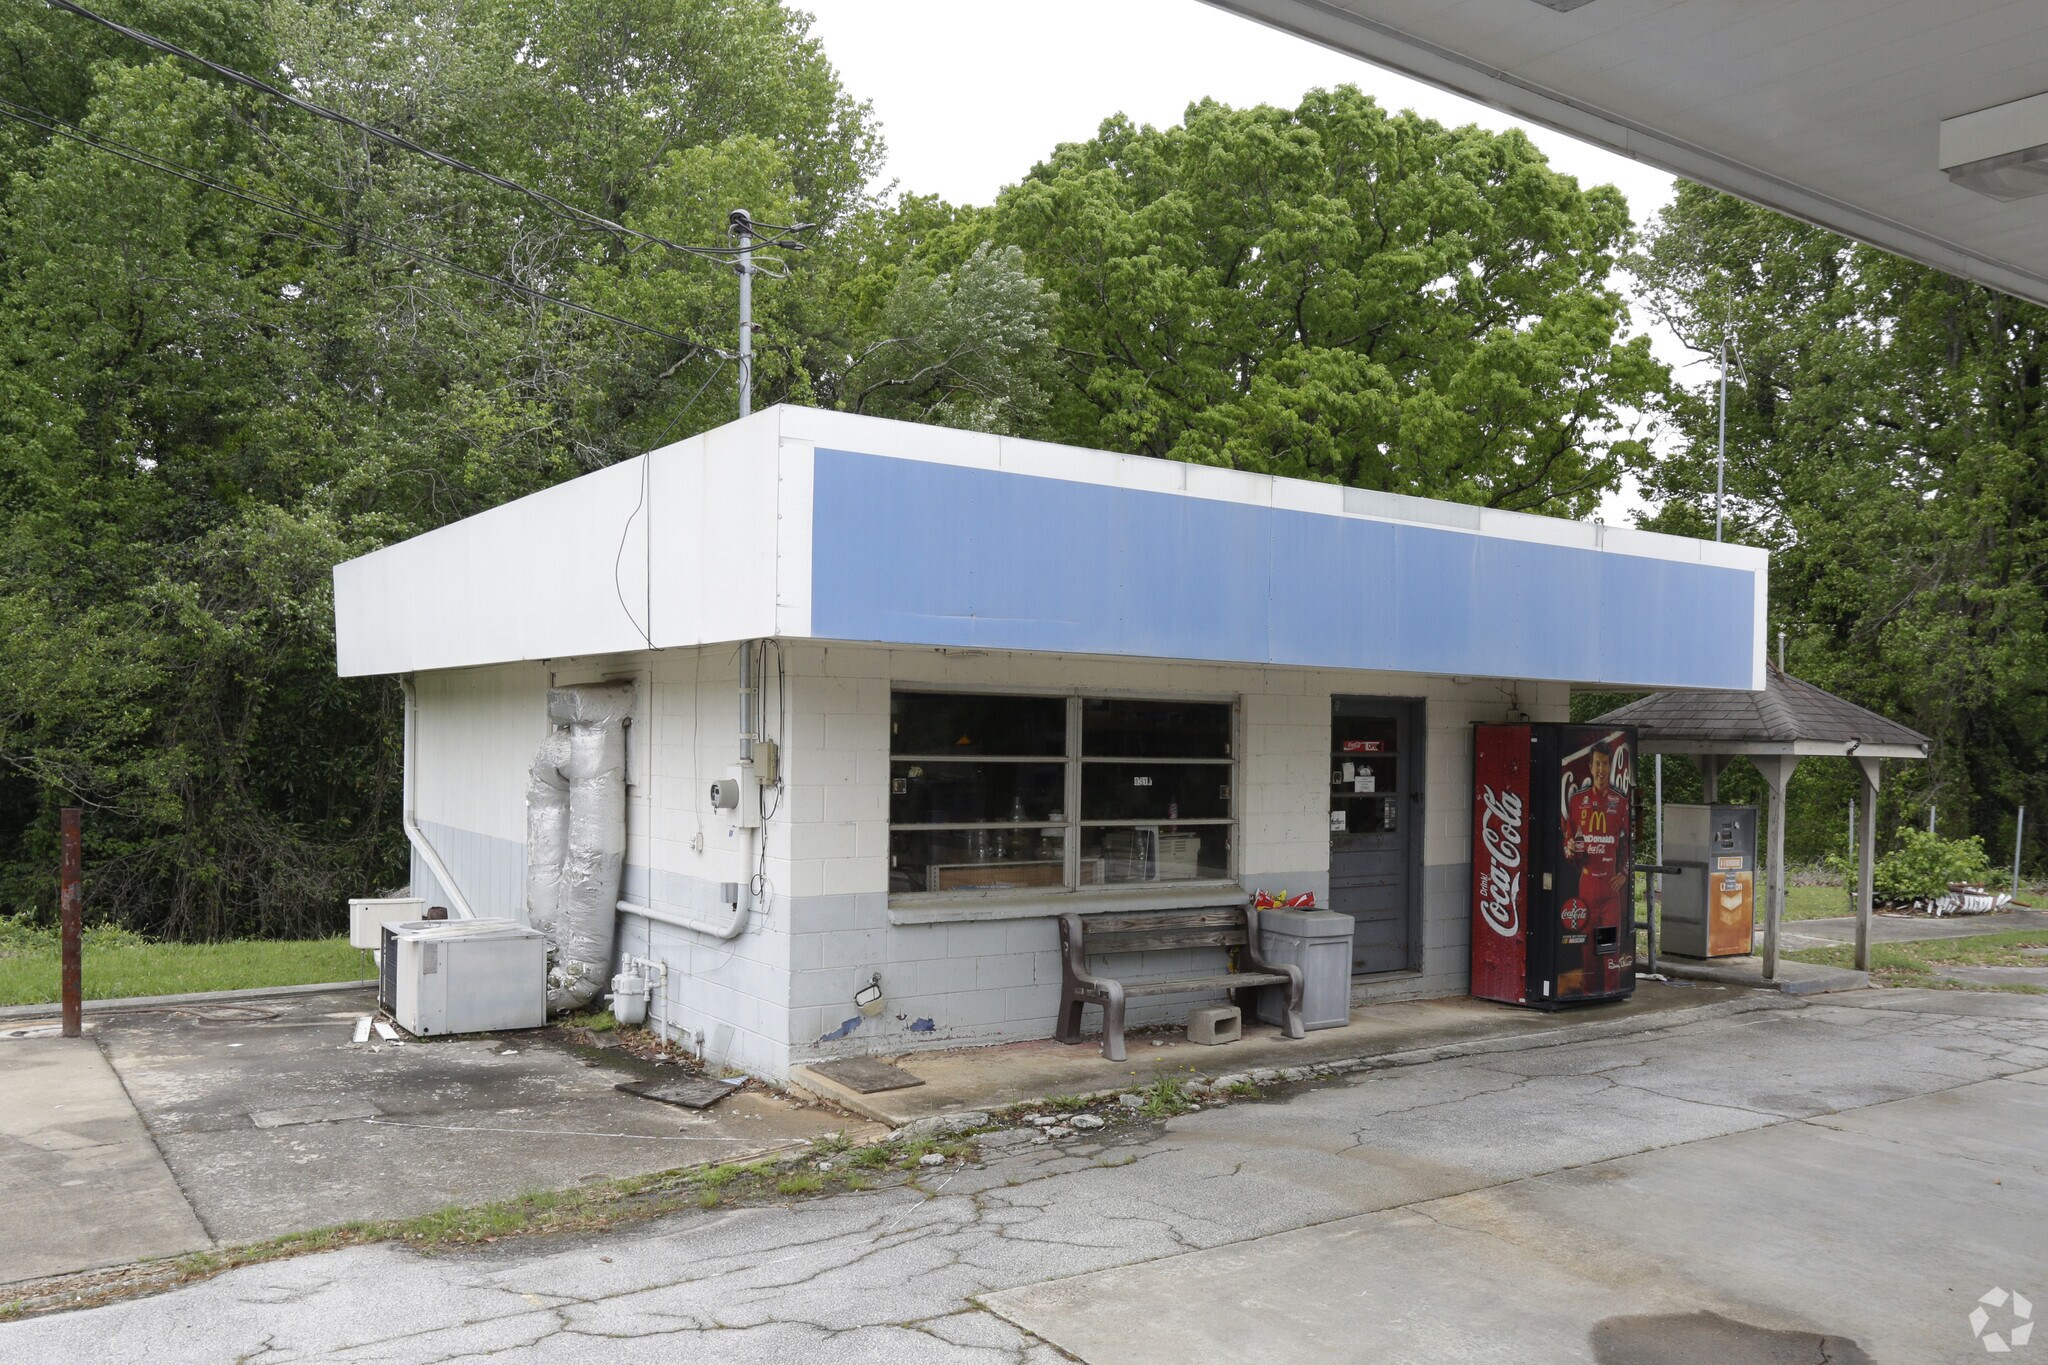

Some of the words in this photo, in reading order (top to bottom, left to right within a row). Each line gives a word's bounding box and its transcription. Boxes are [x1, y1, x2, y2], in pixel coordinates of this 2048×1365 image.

[1481, 784, 1522, 937] Coca-Cola
[1480, 873, 1488, 896] Drink!
[1561, 907, 1588, 920] Coca-Cola
